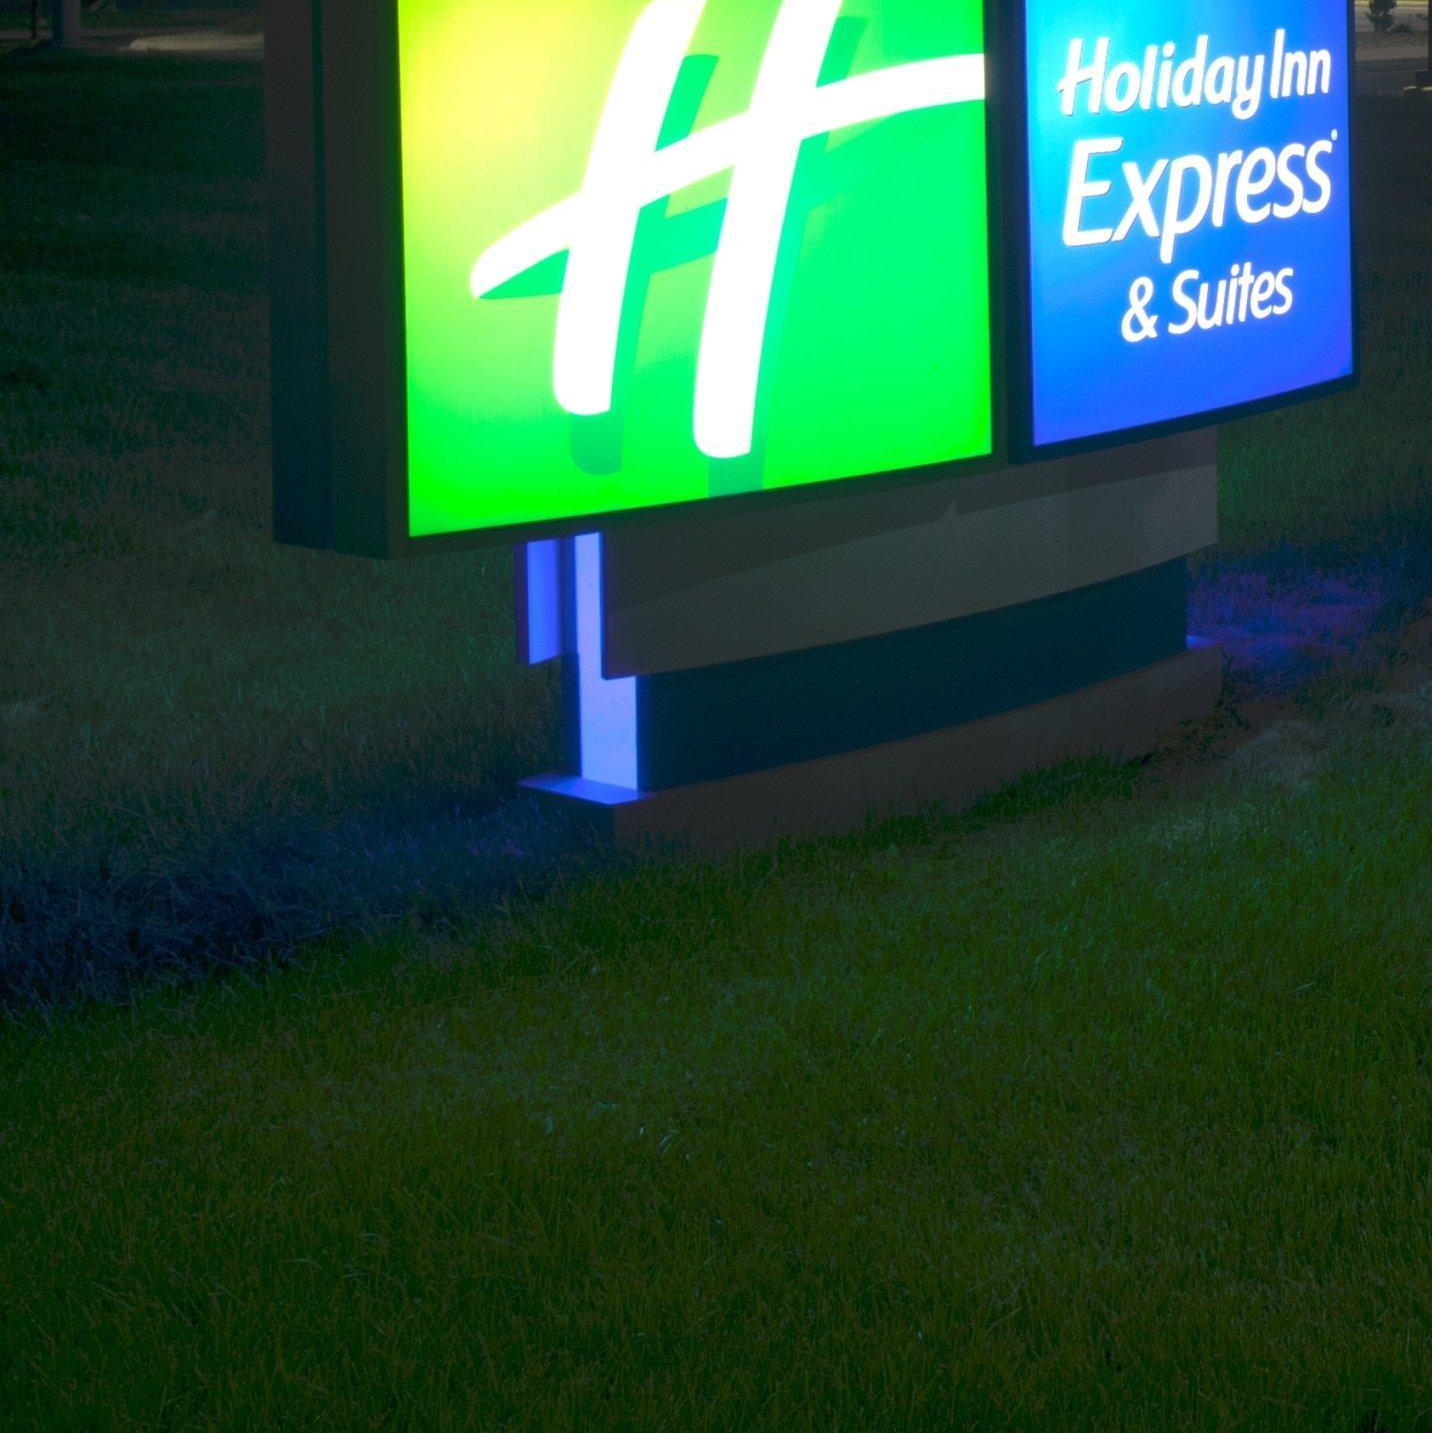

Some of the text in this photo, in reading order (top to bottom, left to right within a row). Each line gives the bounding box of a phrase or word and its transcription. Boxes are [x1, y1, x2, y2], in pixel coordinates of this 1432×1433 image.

[1058, 28, 1332, 121] Holiday Inn
[1061, 134, 1334, 264] Express
[1121, 262, 1294, 343] & Suites
